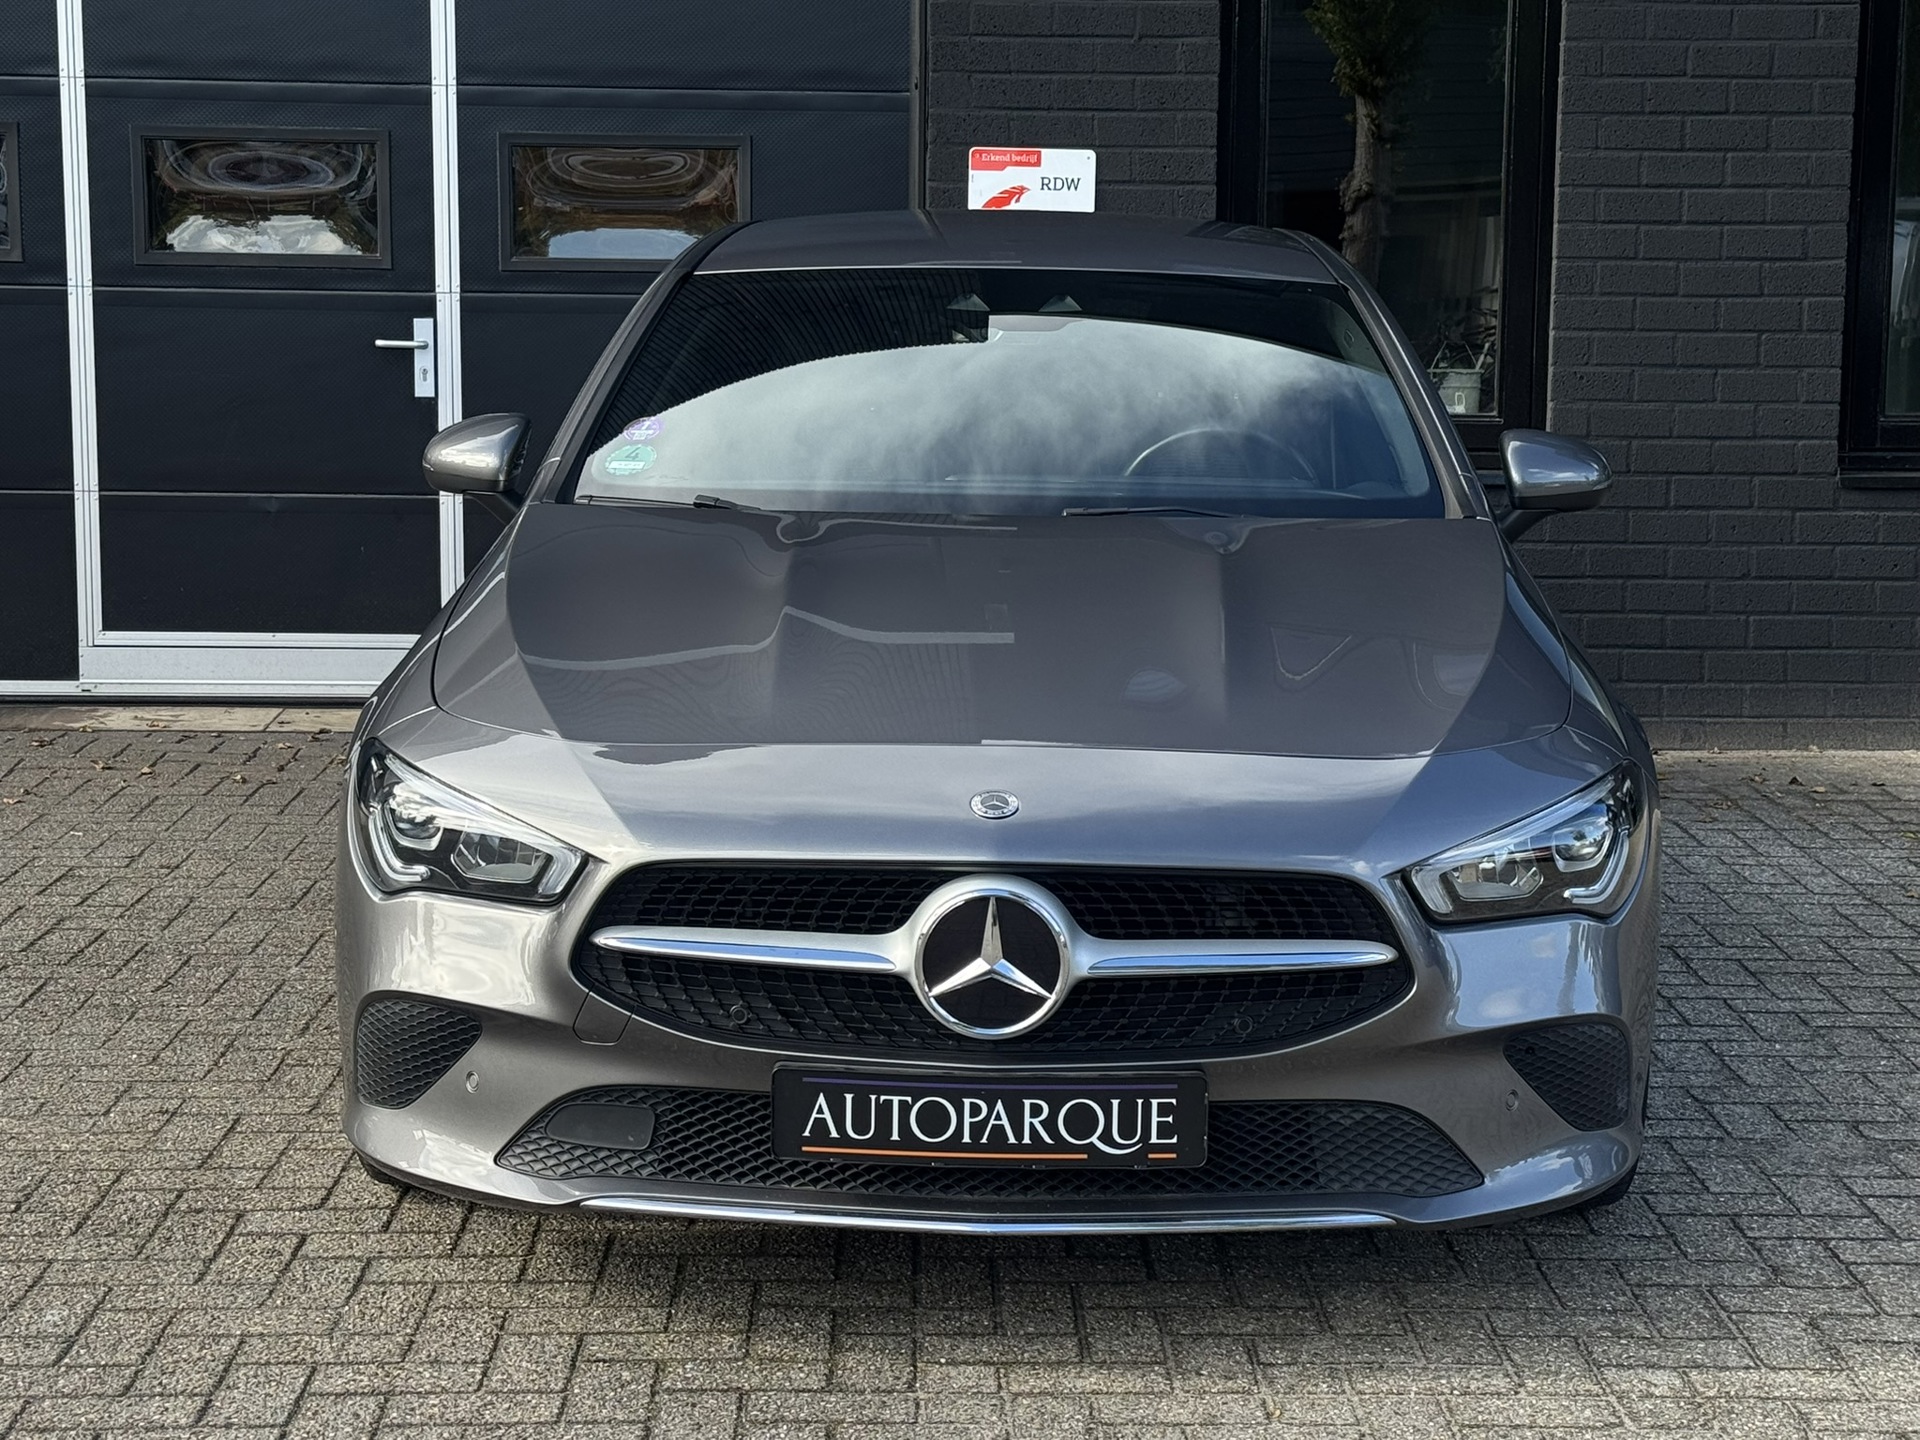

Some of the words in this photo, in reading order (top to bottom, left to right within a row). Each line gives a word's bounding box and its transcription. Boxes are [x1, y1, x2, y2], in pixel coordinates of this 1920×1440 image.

[981, 153, 1010, 162] Erkend
[1011, 153, 1038, 164] bedrijf
[1040, 176, 1081, 191] RDW
[625, 446, 641, 460] 4
[801, 1092, 1178, 1155] AUTOPARQUE
